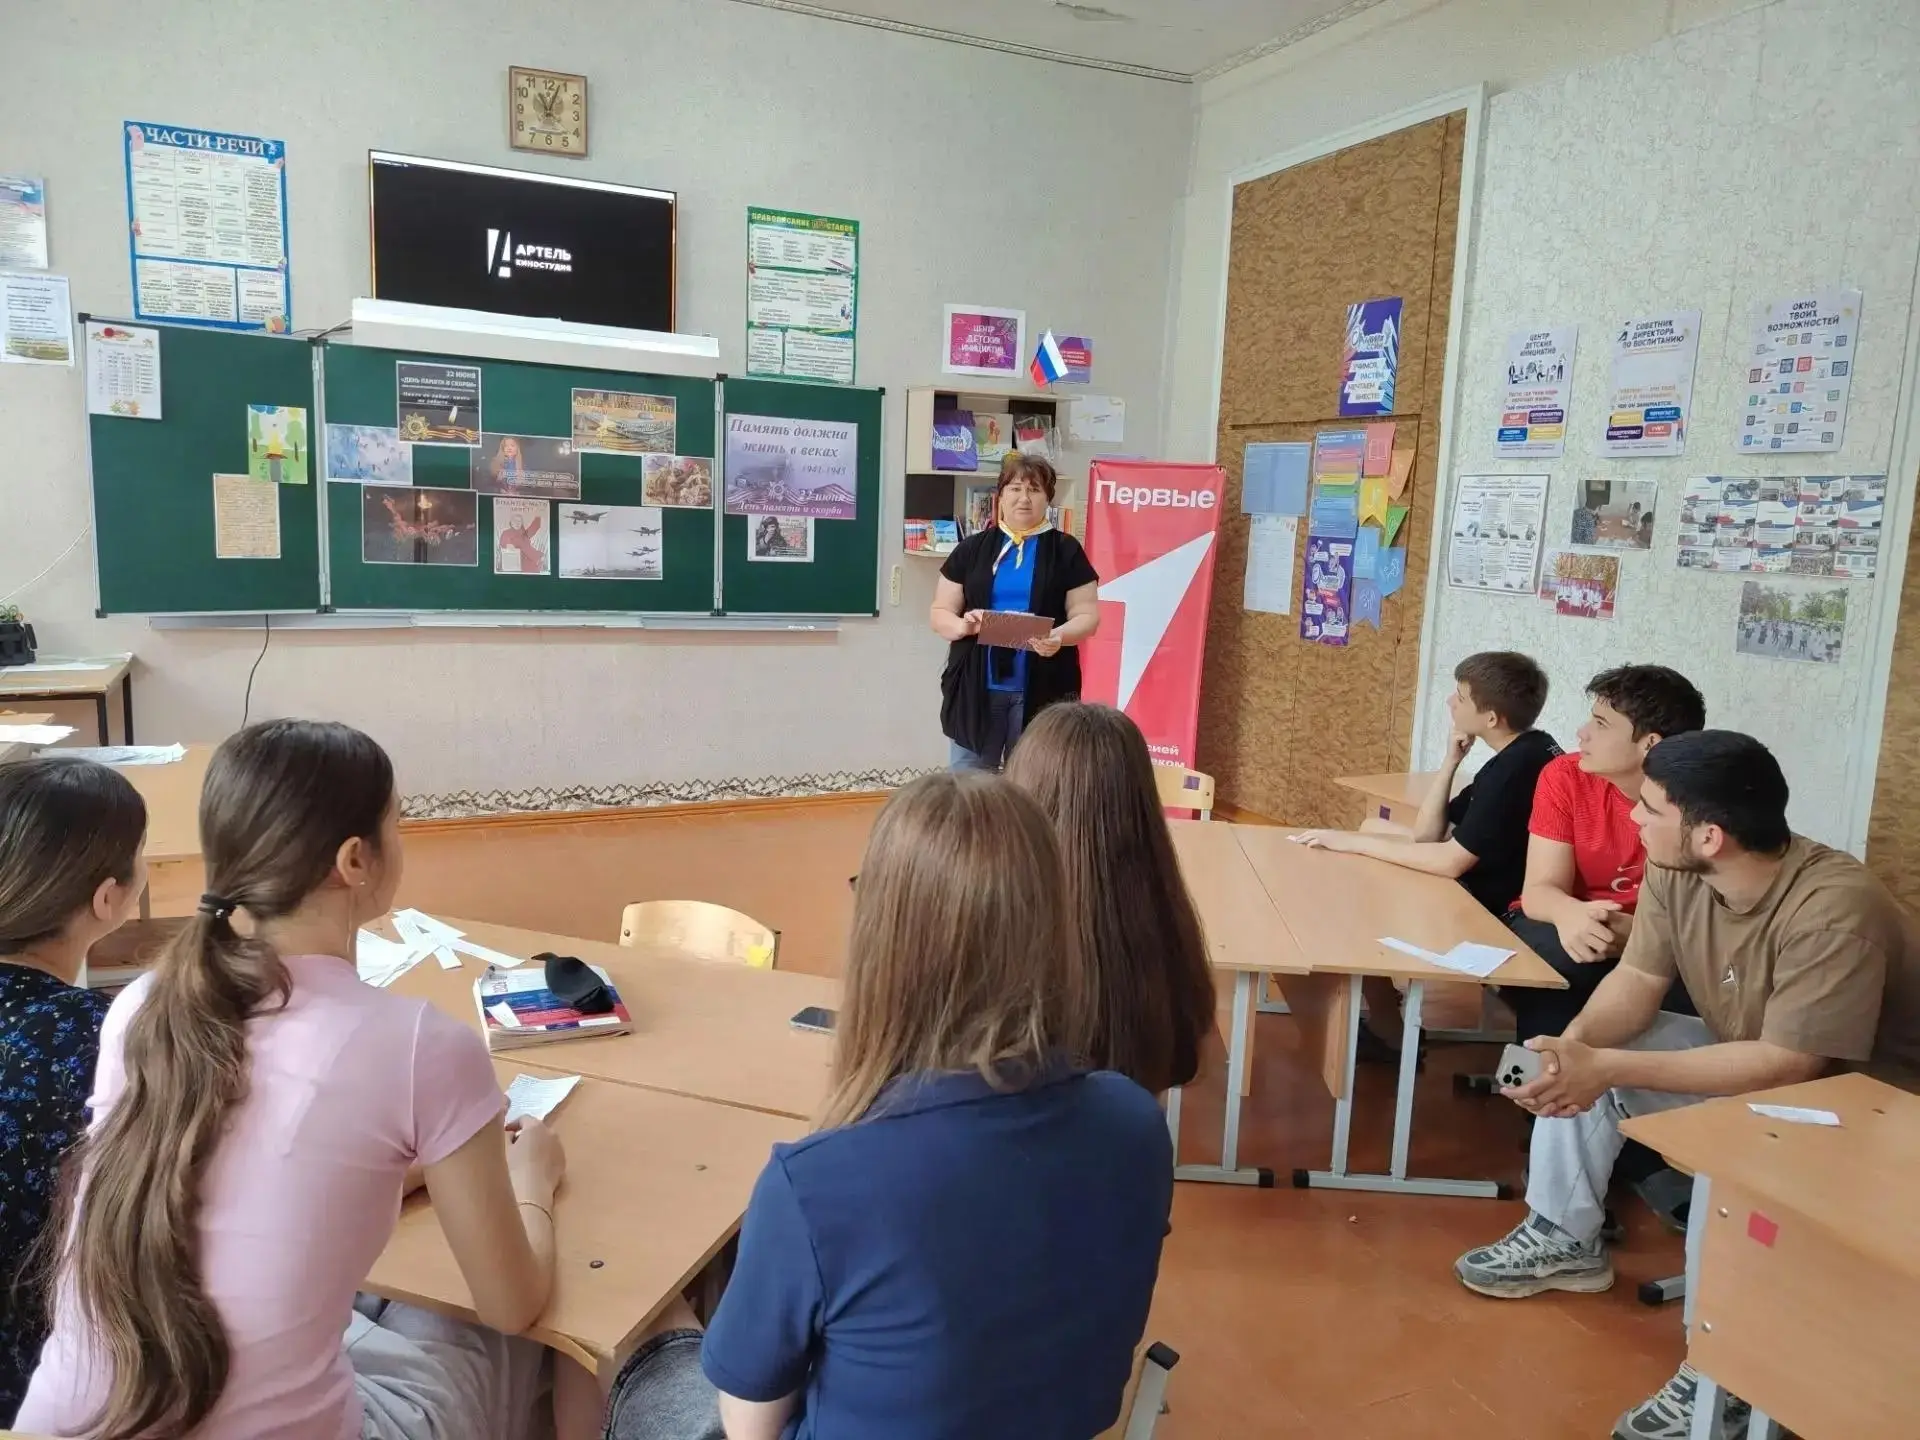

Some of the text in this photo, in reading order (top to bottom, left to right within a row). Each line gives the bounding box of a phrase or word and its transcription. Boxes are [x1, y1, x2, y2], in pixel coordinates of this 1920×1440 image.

[526, 77, 536, 88] 11
[542, 80, 556, 92] 12
[563, 82, 568, 92] 1
[516, 86, 528, 98] 10
[572, 94, 580, 105] 2
[516, 104, 524, 114] 9
[572, 110, 580, 122] 3
[516, 120, 524, 132] 8
[528, 132, 536, 144] 7
[572, 128, 580, 138] 4
[146, 127, 264, 155] ЧАСТИ РЕЧИ
[544, 134, 552, 146] 6
[562, 136, 569, 148] 5
[516, 244, 572, 260] АРТЕЛЬ
[515, 258, 572, 272] КИНОСТУДИЯ
[1792, 300, 1817, 310] ОКНО
[1789, 310, 1818, 319] ТВОИХ
[972, 325, 996, 334] ЦЕНТР
[1636, 320, 1674, 330] СОВЕТНИК
[1767, 314, 1840, 333] ВОЗМОЖНОСТЕЙ
[1530, 332, 1550, 341] ЦЕНТР
[1632, 328, 1674, 340] ДИРЕКТОРА
[1524, 340, 1552, 349] ДЕТСКИХ
[1633, 335, 1685, 348] ВОСПИТАНИЮ
[730, 418, 848, 440] Память должна
[743, 442, 839, 458] жить в веках
[798, 488, 814, 500] 22
[1096, 480, 1215, 512] Первые
[736, 502, 760, 511] День
[762, 504, 800, 513] памяти
